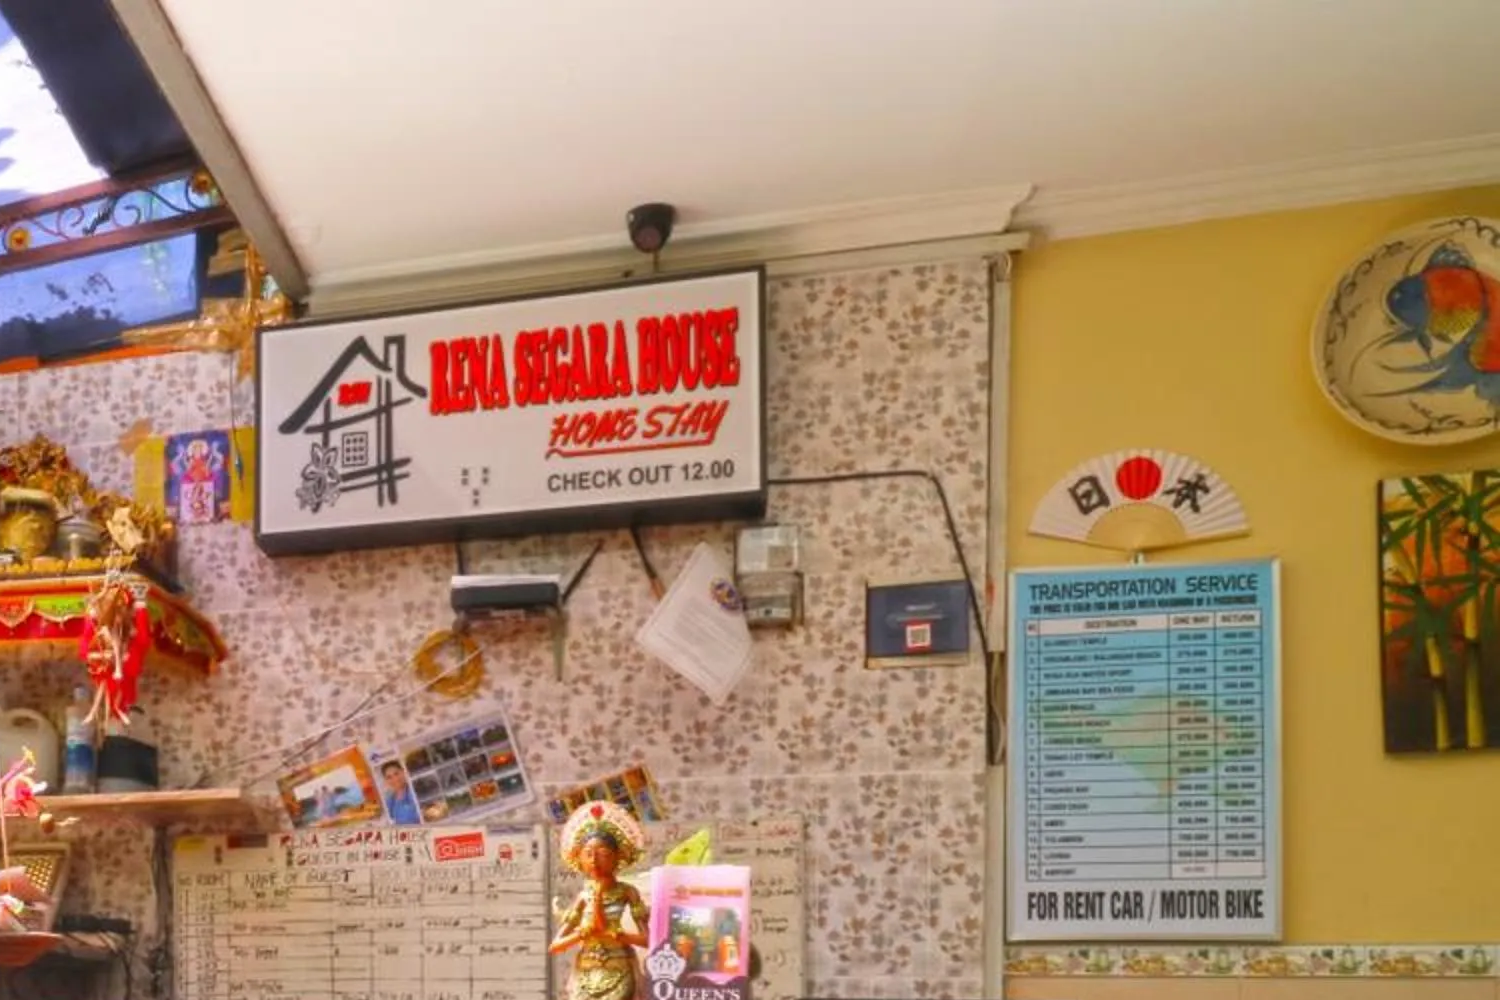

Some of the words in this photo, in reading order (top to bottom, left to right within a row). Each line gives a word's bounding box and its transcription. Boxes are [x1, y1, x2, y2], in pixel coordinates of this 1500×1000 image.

[429, 334, 508, 416] RENA
[513, 320, 631, 407] SEGARA
[636, 307, 740, 396] HOUSE
[548, 408, 638, 448] HOME
[642, 400, 729, 444] STAY
[547, 469, 622, 493] CHECK
[628, 464, 675, 487] OUT
[681, 458, 735, 482] 12.00
[1029, 577, 1176, 600] TRANSPORTATION
[1185, 573, 1258, 593] SERVICE
[1028, 891, 1059, 920] FOR
[1063, 891, 1106, 920] RENT
[1110, 890, 1145, 920] CAR
[1160, 889, 1220, 919] MOTOR
[1225, 889, 1264, 919] BIKE
